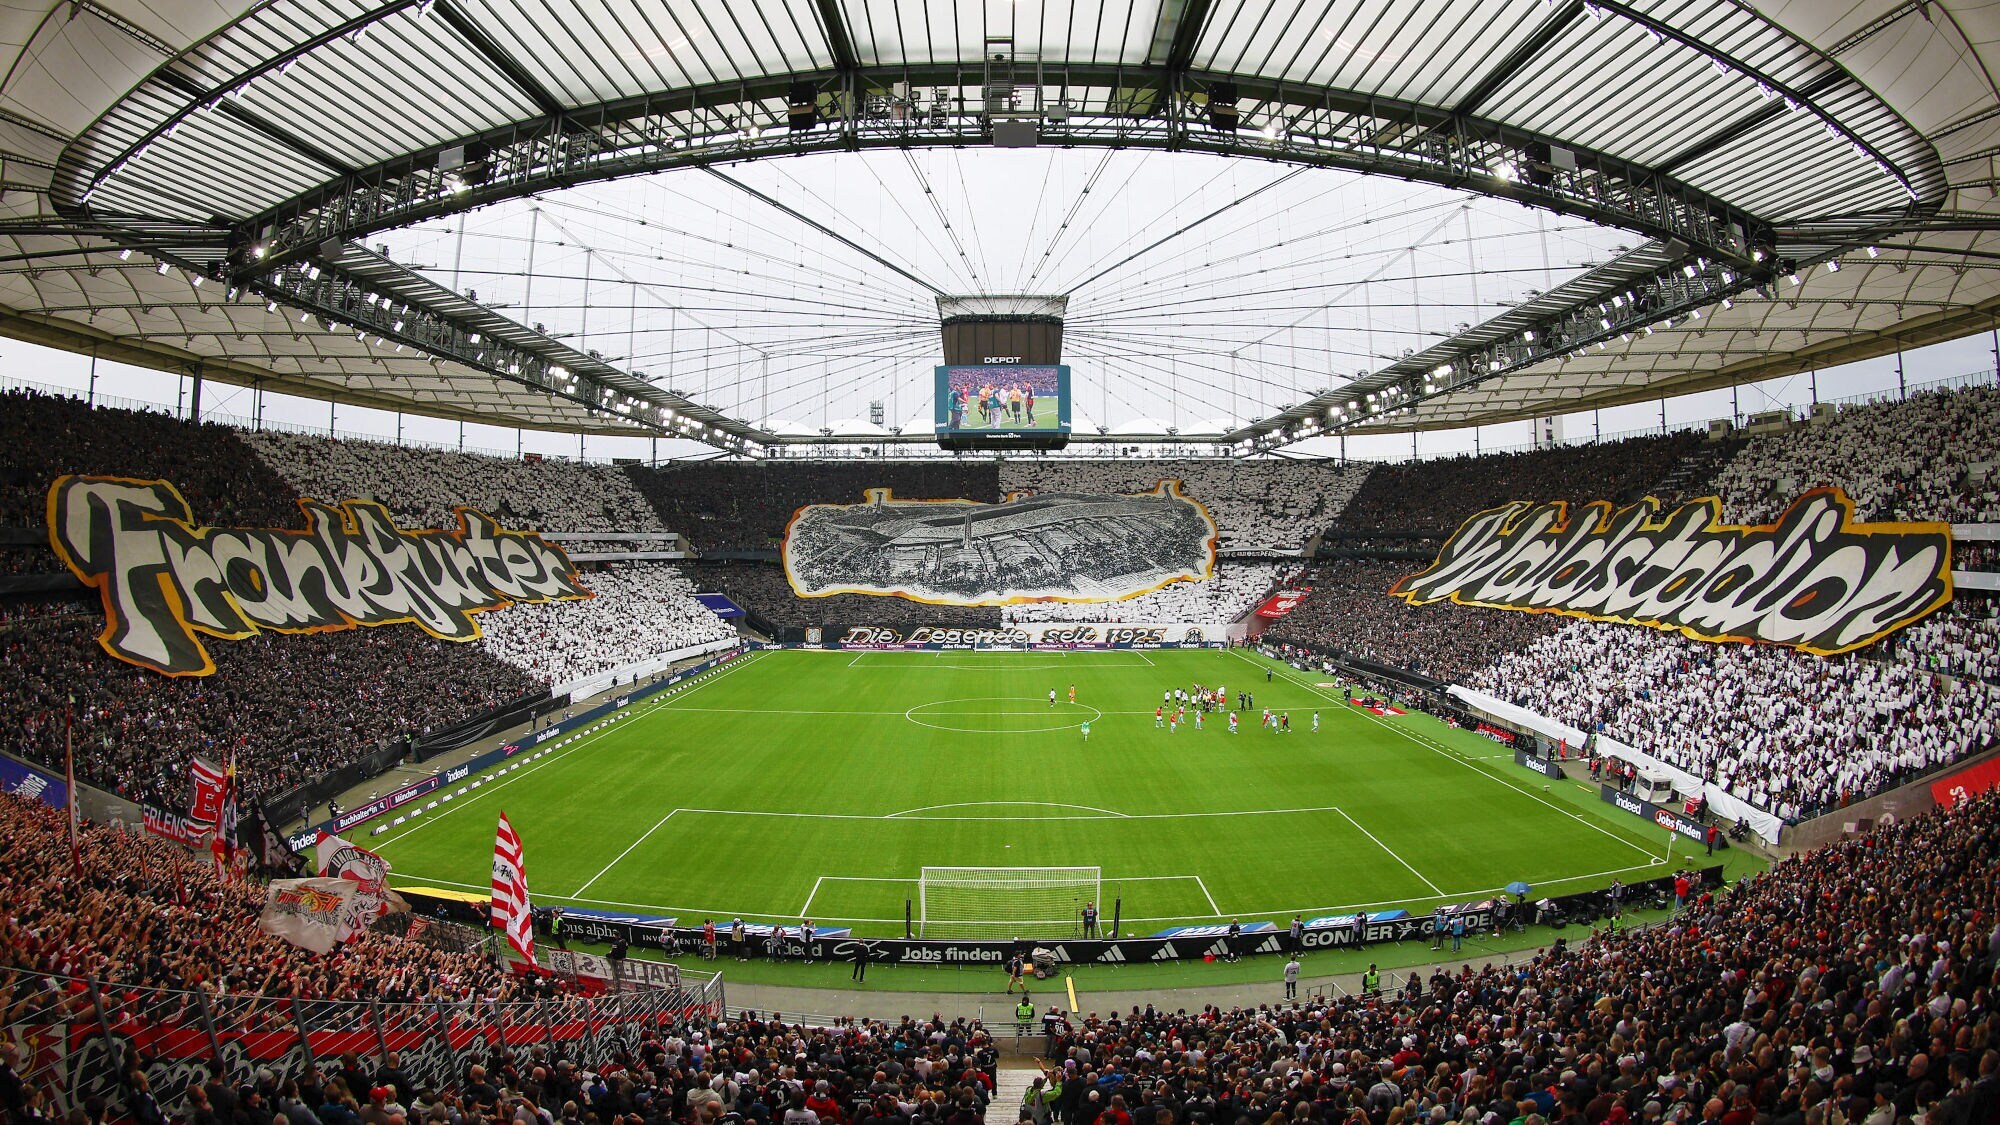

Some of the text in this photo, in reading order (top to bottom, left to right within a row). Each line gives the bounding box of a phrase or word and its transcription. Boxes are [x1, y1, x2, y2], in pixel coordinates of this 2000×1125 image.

[984, 356, 1021, 364] DEPOT
[60, 477, 574, 669] Frankfurter
[1404, 494, 1940, 648] Waldstadion
[840, 625, 1167, 644] Die Legende seit 1925
[446, 764, 469, 783] indeed
[1525, 754, 1547, 775] indeed
[394, 788, 418, 804] München
[1615, 791, 1702, 841] indeed Jobs finden
[288, 828, 321, 851] indee
[331, 848, 360, 869] UNION
[901, 946, 1003, 962] Jobs finden
[1054, 1025, 1064, 1034] 90
[986, 1054, 992, 1063] 7
[777, 1089, 785, 1104] 9
